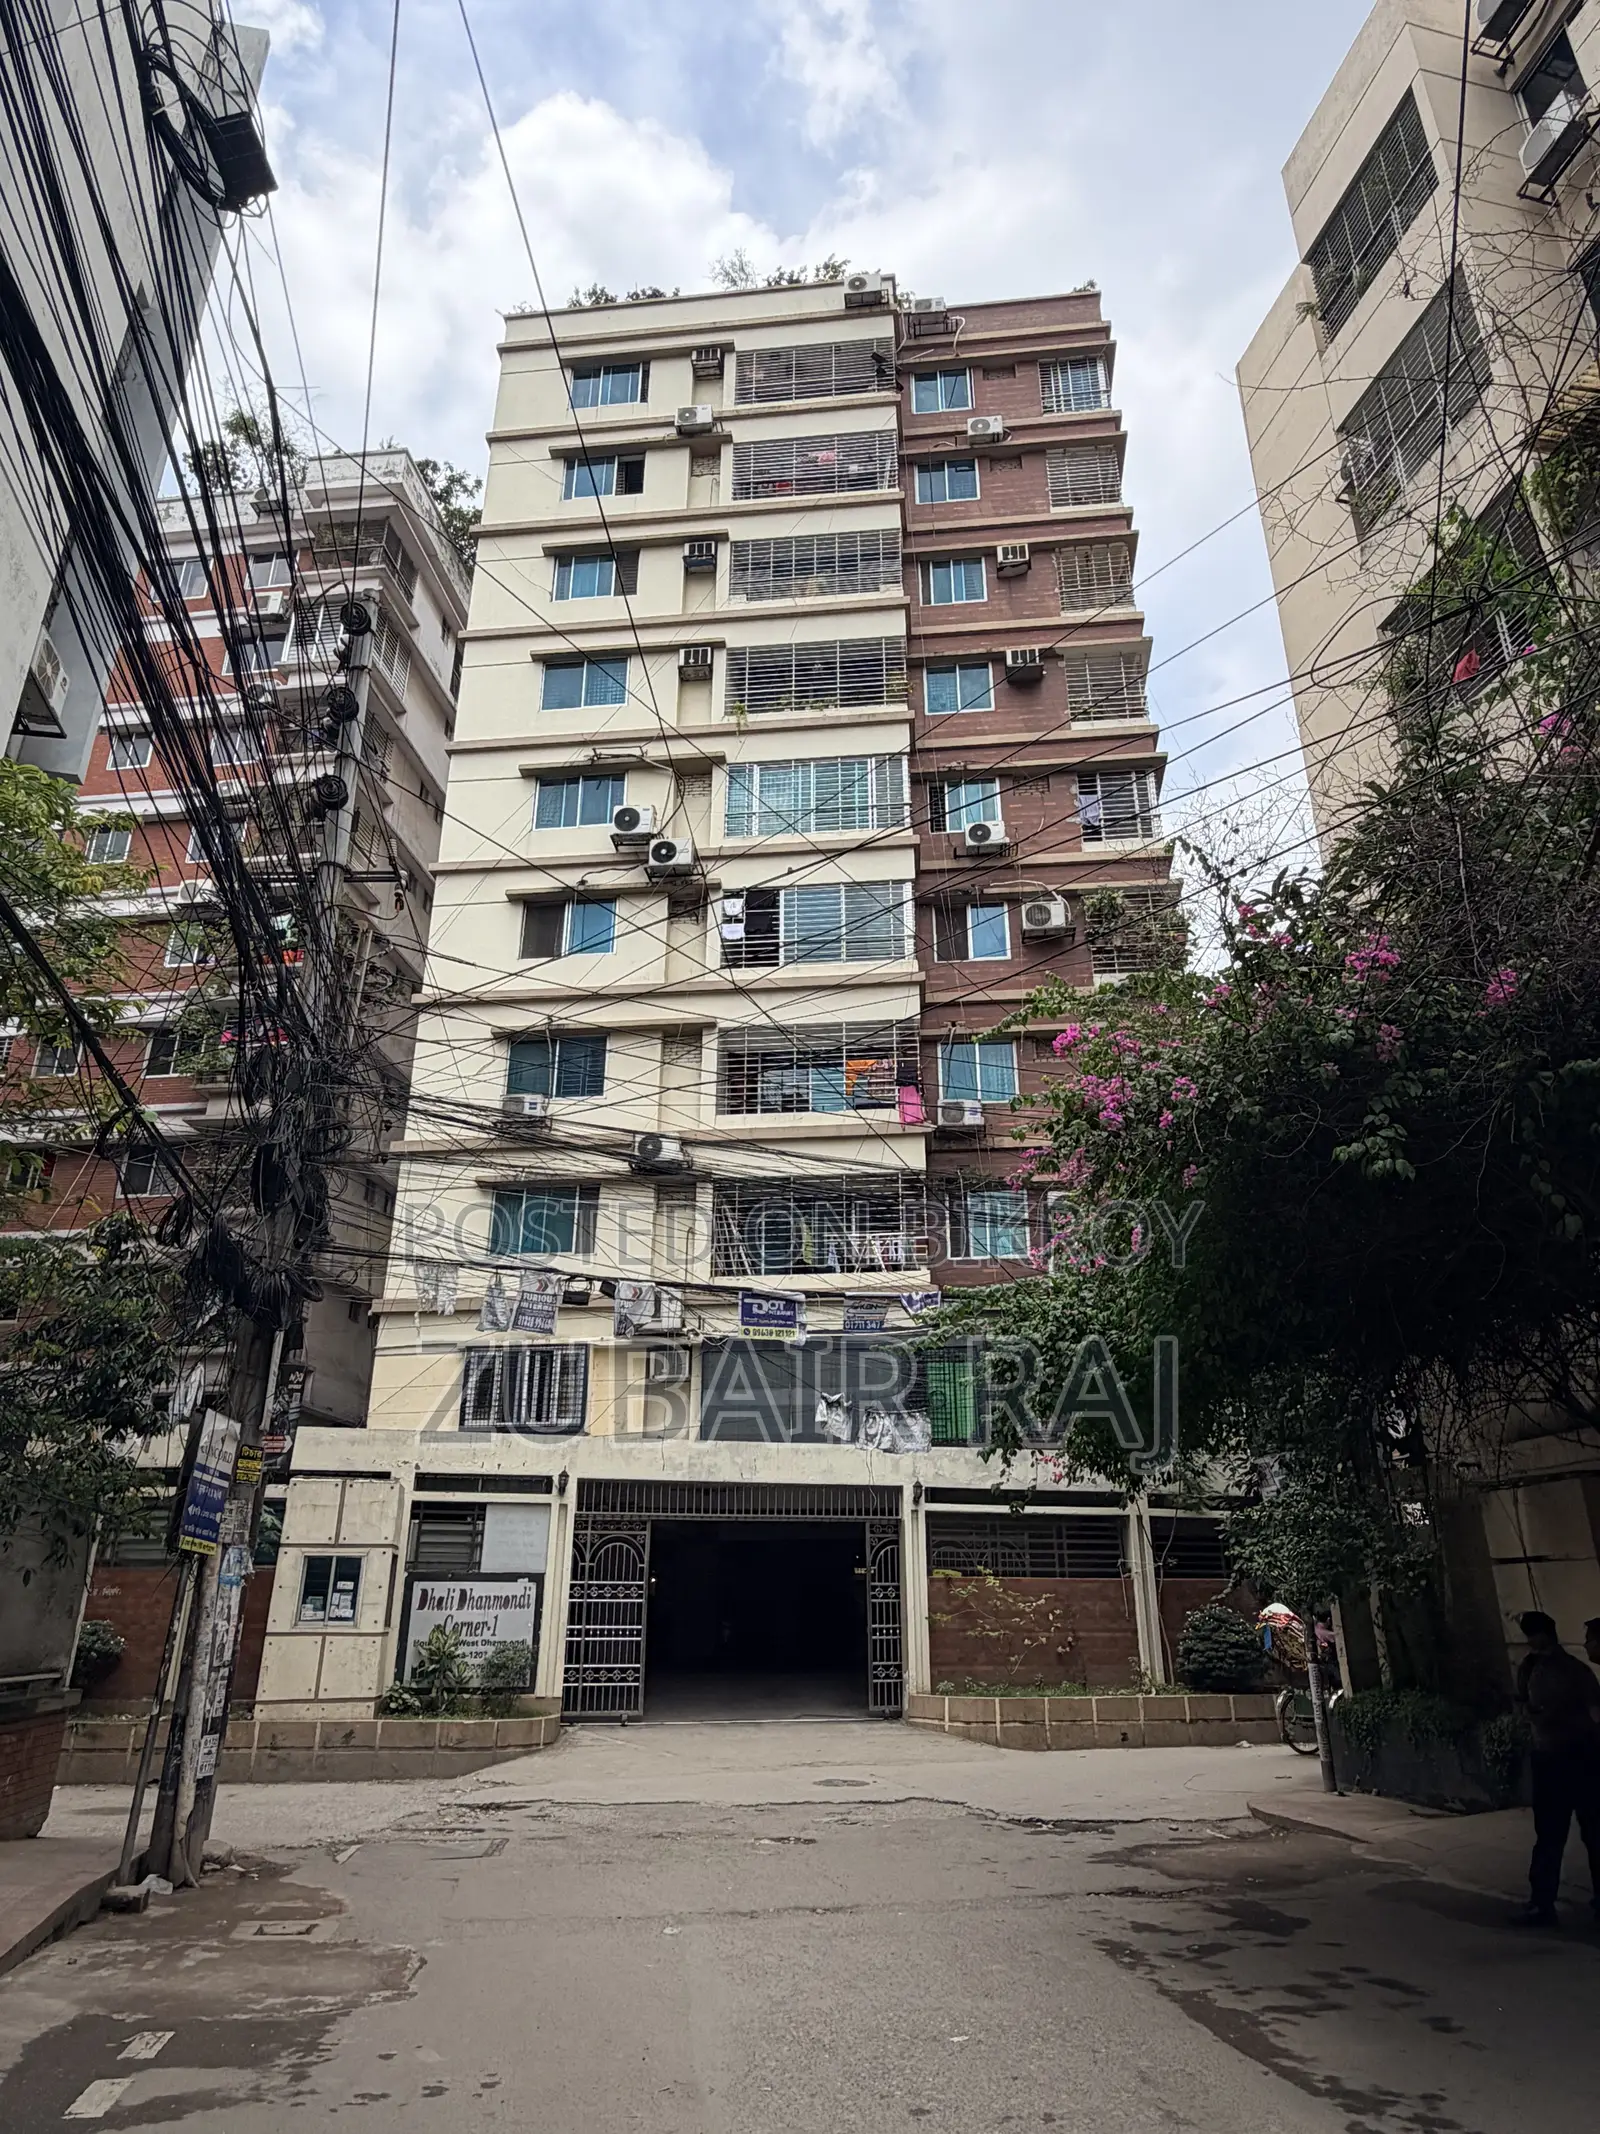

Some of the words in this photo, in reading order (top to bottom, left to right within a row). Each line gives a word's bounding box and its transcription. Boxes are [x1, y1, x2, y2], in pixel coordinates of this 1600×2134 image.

[523, 1292, 556, 1304] FURIOUS
[744, 1298, 786, 1315] DOT
[416, 1588, 456, 1611] Dhali
[456, 1586, 532, 1611] Dhanmondi
[443, 1614, 499, 1638] Corner-1
[459, 1639, 479, 1647] West
